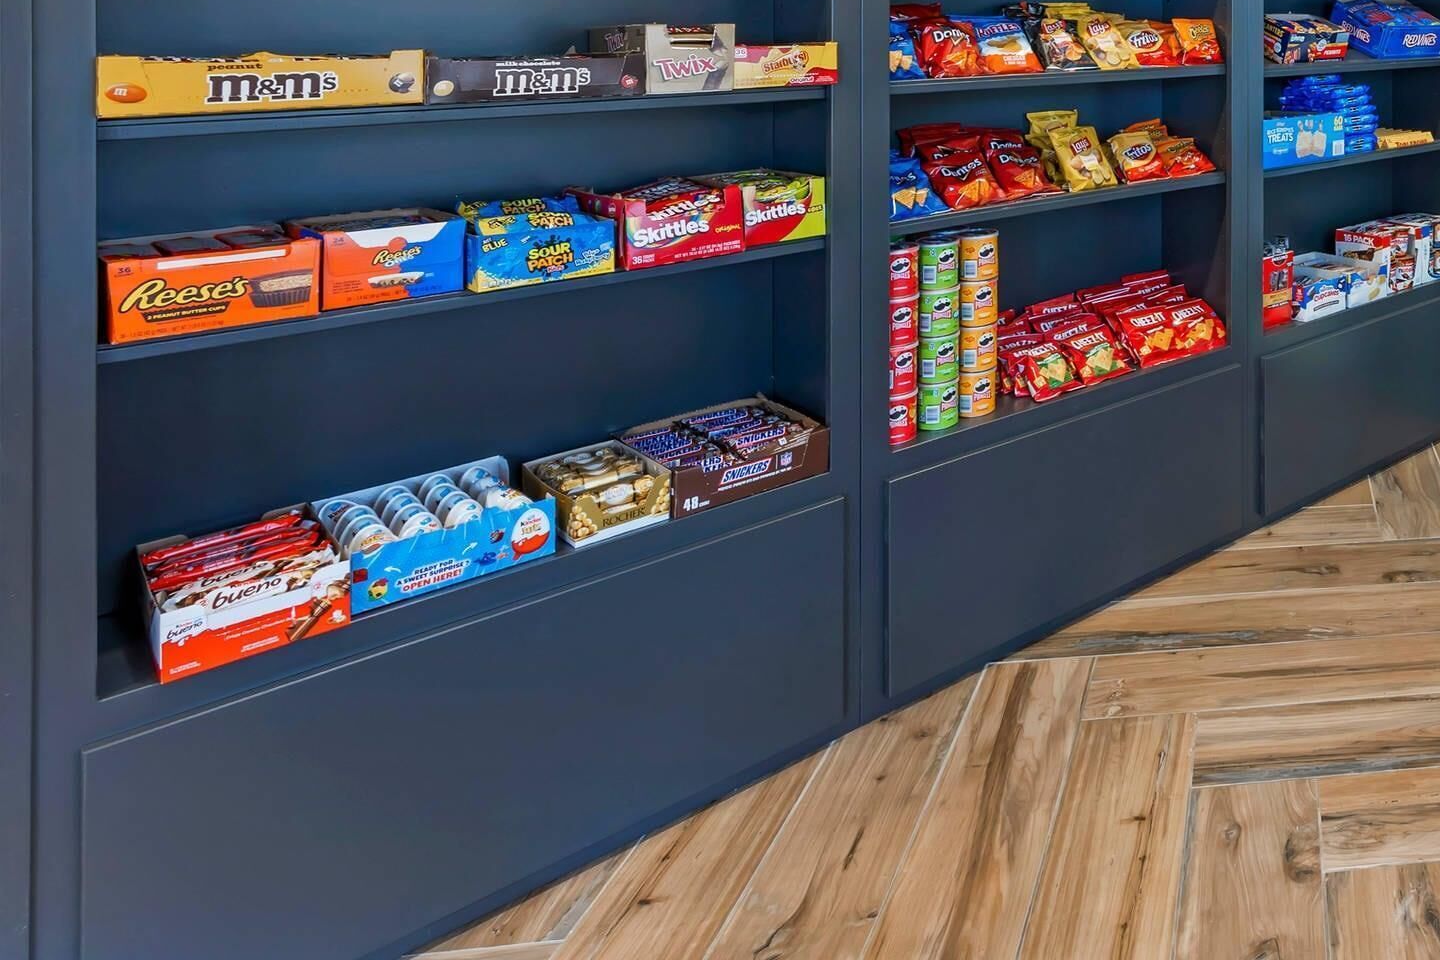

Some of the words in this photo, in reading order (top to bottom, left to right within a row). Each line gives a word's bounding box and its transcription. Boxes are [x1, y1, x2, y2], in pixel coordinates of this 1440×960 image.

[207, 62, 263, 72] peanut
[654, 54, 720, 81] Twix
[206, 72, 338, 103] m&m's
[493, 67, 590, 96] m&m's
[1333, 115, 1343, 125] 60
[1267, 132, 1294, 144] TREATS
[1125, 143, 1152, 160] Fritos
[530, 216, 574, 227] PATCH
[745, 203, 806, 227] Skittles
[633, 220, 710, 248] Skittles
[1353, 235, 1375, 246] PACK
[482, 238, 508, 253] BLUE
[528, 242, 572, 260] SOUR
[372, 246, 422, 266] Reese's
[527, 252, 574, 272] PATCH
[632, 256, 643, 265] 36
[119, 276, 249, 313] Reese's
[153, 312, 180, 320] PEANUT
[181, 308, 207, 316] BUTTER
[1130, 312, 1166, 327] CHEEZ-IT
[1171, 305, 1205, 320] CHEEZ-IT
[737, 427, 785, 448] SNICKERS
[723, 460, 770, 482] SNICKERS
[683, 497, 699, 510] 48
[602, 506, 646, 528] ROCHER
[200, 562, 269, 587] bueno
[396, 578, 403, 586] A
[403, 573, 427, 584] SWEET
[429, 563, 464, 576] SURPRISE
[414, 564, 437, 575] READY
[440, 560, 453, 569] FOR
[403, 577, 431, 592] OPEN
[433, 569, 463, 583] HERE!
[212, 577, 282, 610] bueno
[166, 621, 203, 640] bueno
